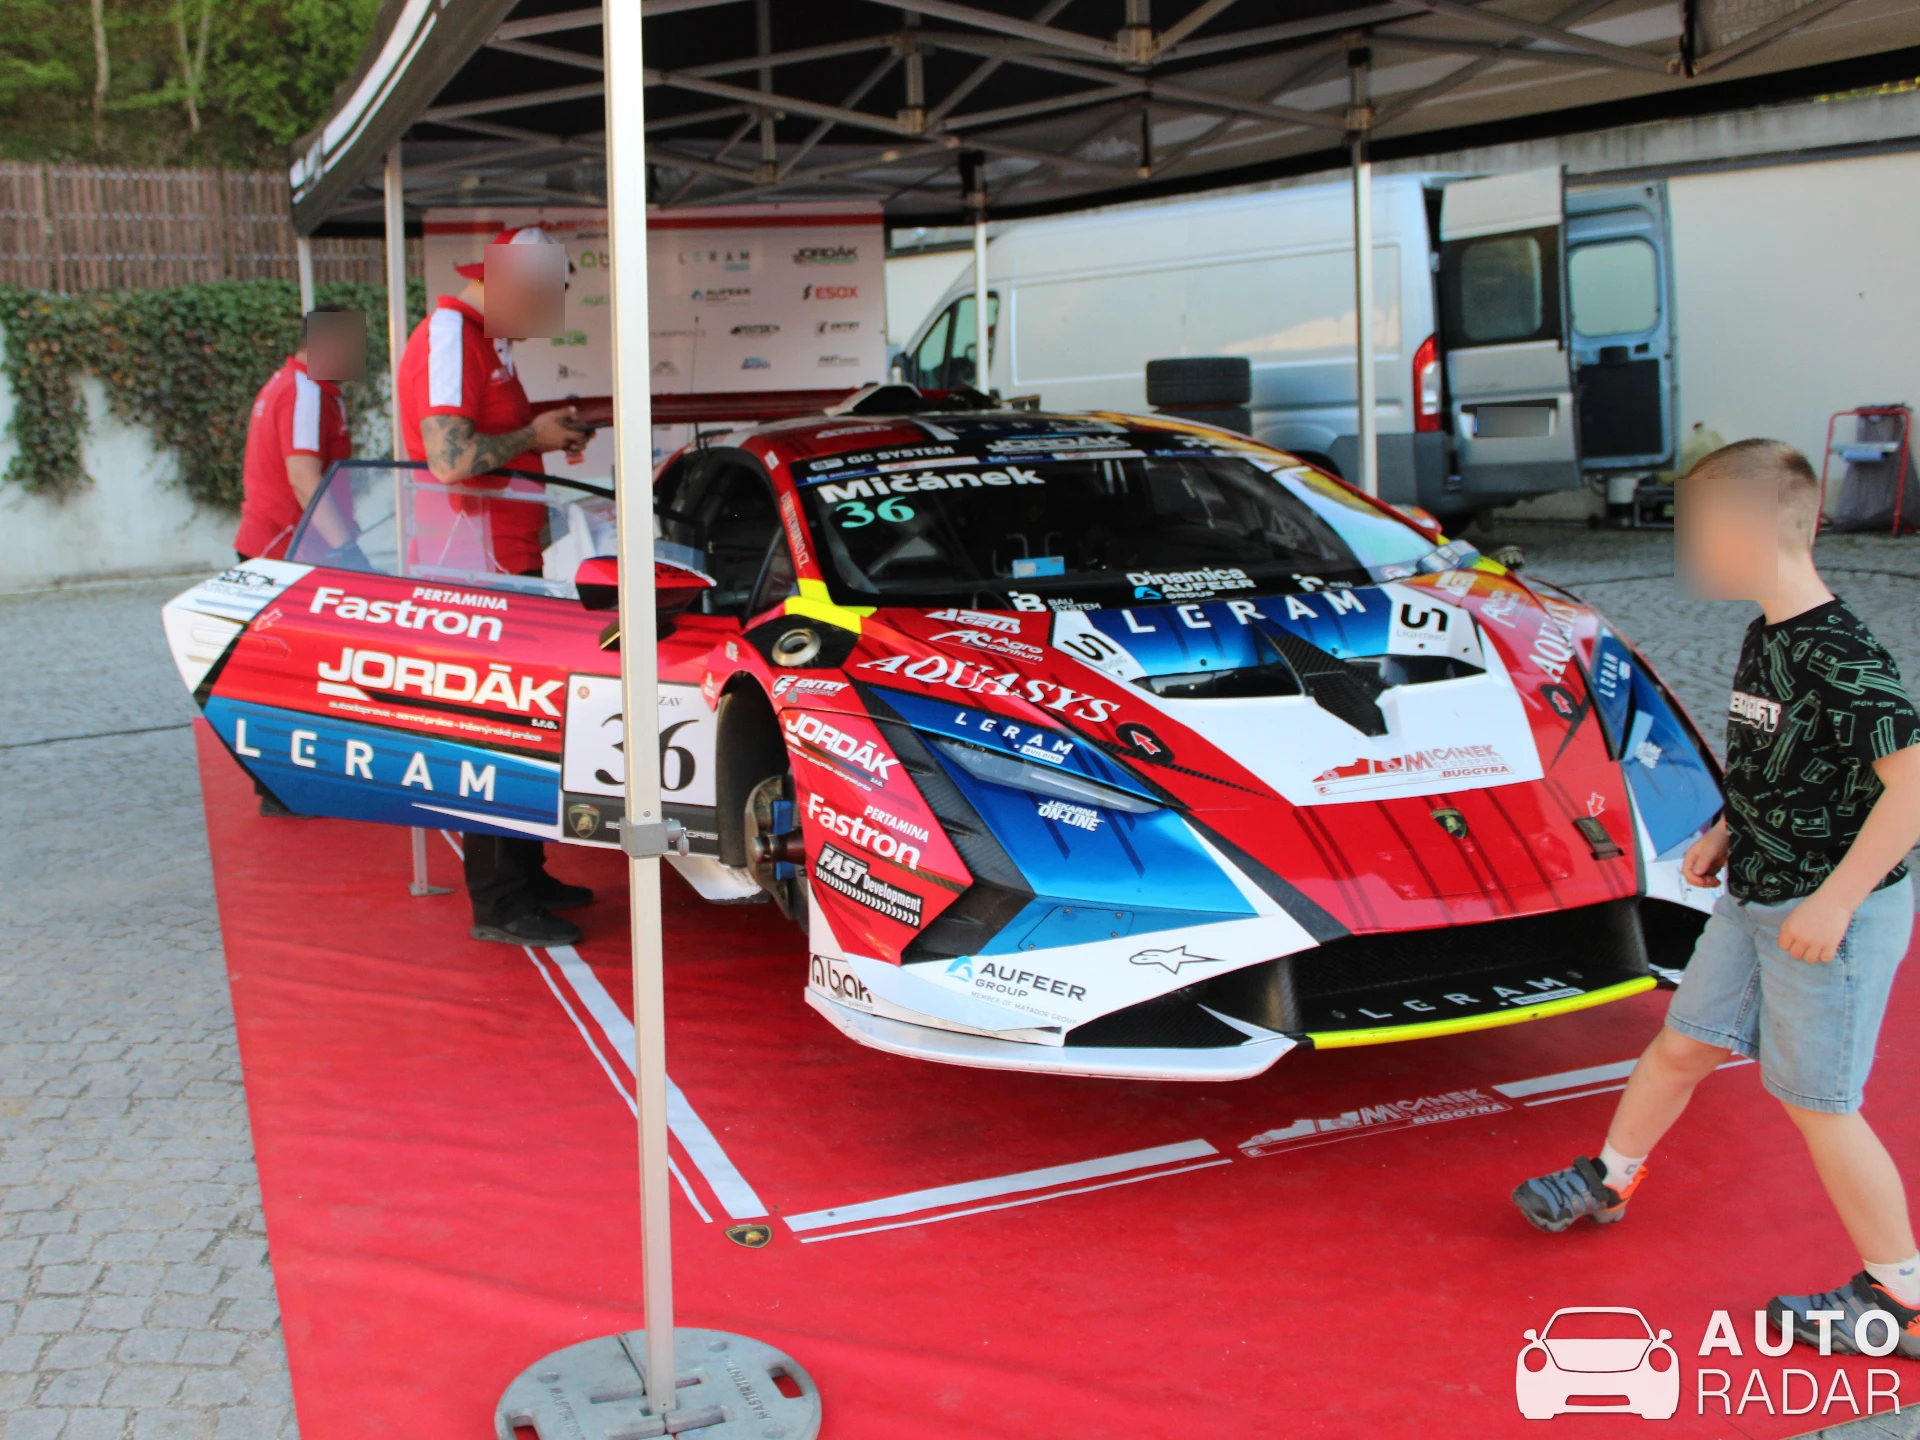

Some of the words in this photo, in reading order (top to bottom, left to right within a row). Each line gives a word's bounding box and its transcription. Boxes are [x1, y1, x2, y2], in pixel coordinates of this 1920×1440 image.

[815, 286, 858, 299] ESOX
[876, 446, 955, 460] SYSTEM
[817, 466, 1046, 503] Mičánek
[835, 496, 915, 528] 36
[1125, 567, 1247, 587] Dinamica
[1160, 579, 1256, 594] AUFEER
[412, 587, 508, 611] PERTAMINA
[1052, 603, 1102, 612] SYSTEM
[1165, 591, 1215, 600] GROUP
[309, 587, 503, 643] Fastron
[1121, 586, 1366, 634] LERAM
[993, 637, 1043, 654] Agro
[1396, 630, 1447, 641] LIGHTING
[985, 644, 1044, 662] centrum
[796, 678, 850, 692] ENTRY
[857, 655, 1120, 723] AQUASYS
[531, 717, 558, 730] s.r.o.
[954, 711, 1075, 755] LERAM
[235, 718, 497, 802] LERAM
[1025, 748, 1061, 762] BUILDING
[1442, 765, 1510, 778] BUGGYRA
[864, 805, 930, 843] PERTAMINA
[1038, 804, 1100, 832] ON-LINE
[808, 792, 920, 870] Fastron
[818, 847, 868, 885] FAST
[863, 873, 921, 913] Development
[975, 978, 1028, 999] GROUP
[980, 962, 1087, 1002] AUFEER
[970, 990, 998, 1004] MEMBER
[1001, 999, 1012, 1007] OF
[1014, 1003, 1050, 1019] MATADOR
[1051, 1013, 1078, 1026] GROUP
[1358, 977, 1568, 1019] LERAM
[1412, 1103, 1505, 1125] BUGGYRA
